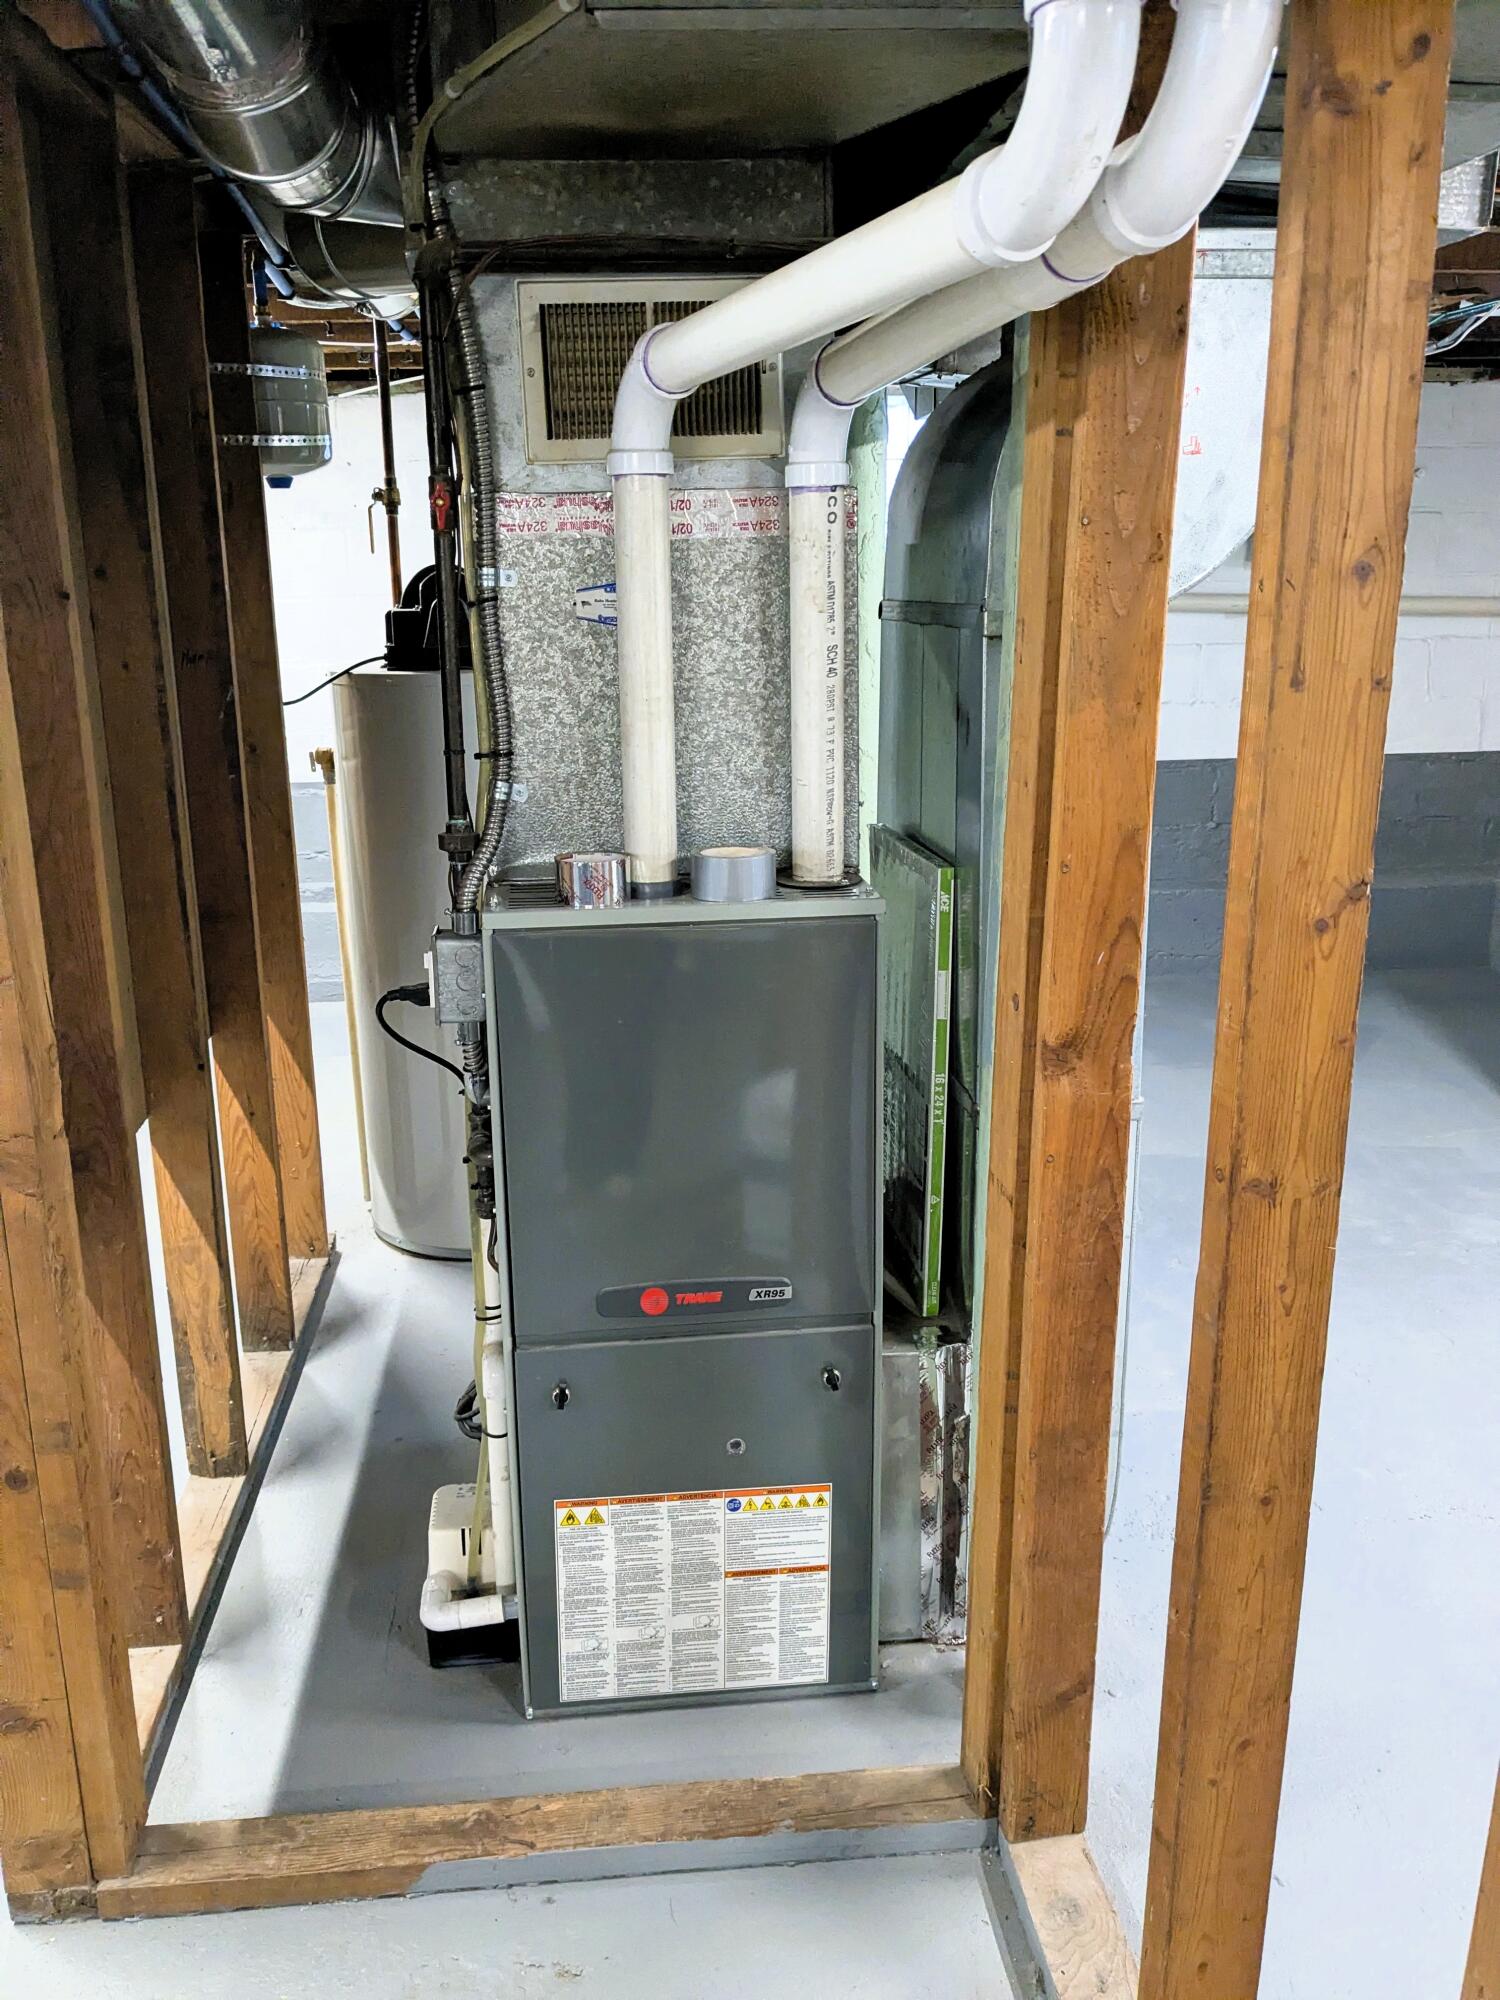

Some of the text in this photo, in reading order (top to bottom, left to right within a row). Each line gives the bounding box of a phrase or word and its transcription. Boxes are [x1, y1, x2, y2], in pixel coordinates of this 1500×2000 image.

[516, 496, 546, 508] 324A
[751, 496, 779, 508] 324A
[518, 520, 548, 532] 324A
[752, 520, 780, 531] 324A
[826, 644, 838, 665] SCH
[826, 666, 838, 678] 40
[826, 748, 836, 762] PVC
[826, 828, 835, 846] ASTM
[940, 891, 950, 912] ACE
[935, 1072, 945, 1084] 16
[934, 1095, 945, 1106] 24
[675, 1289, 786, 1304] TRANE XR95
